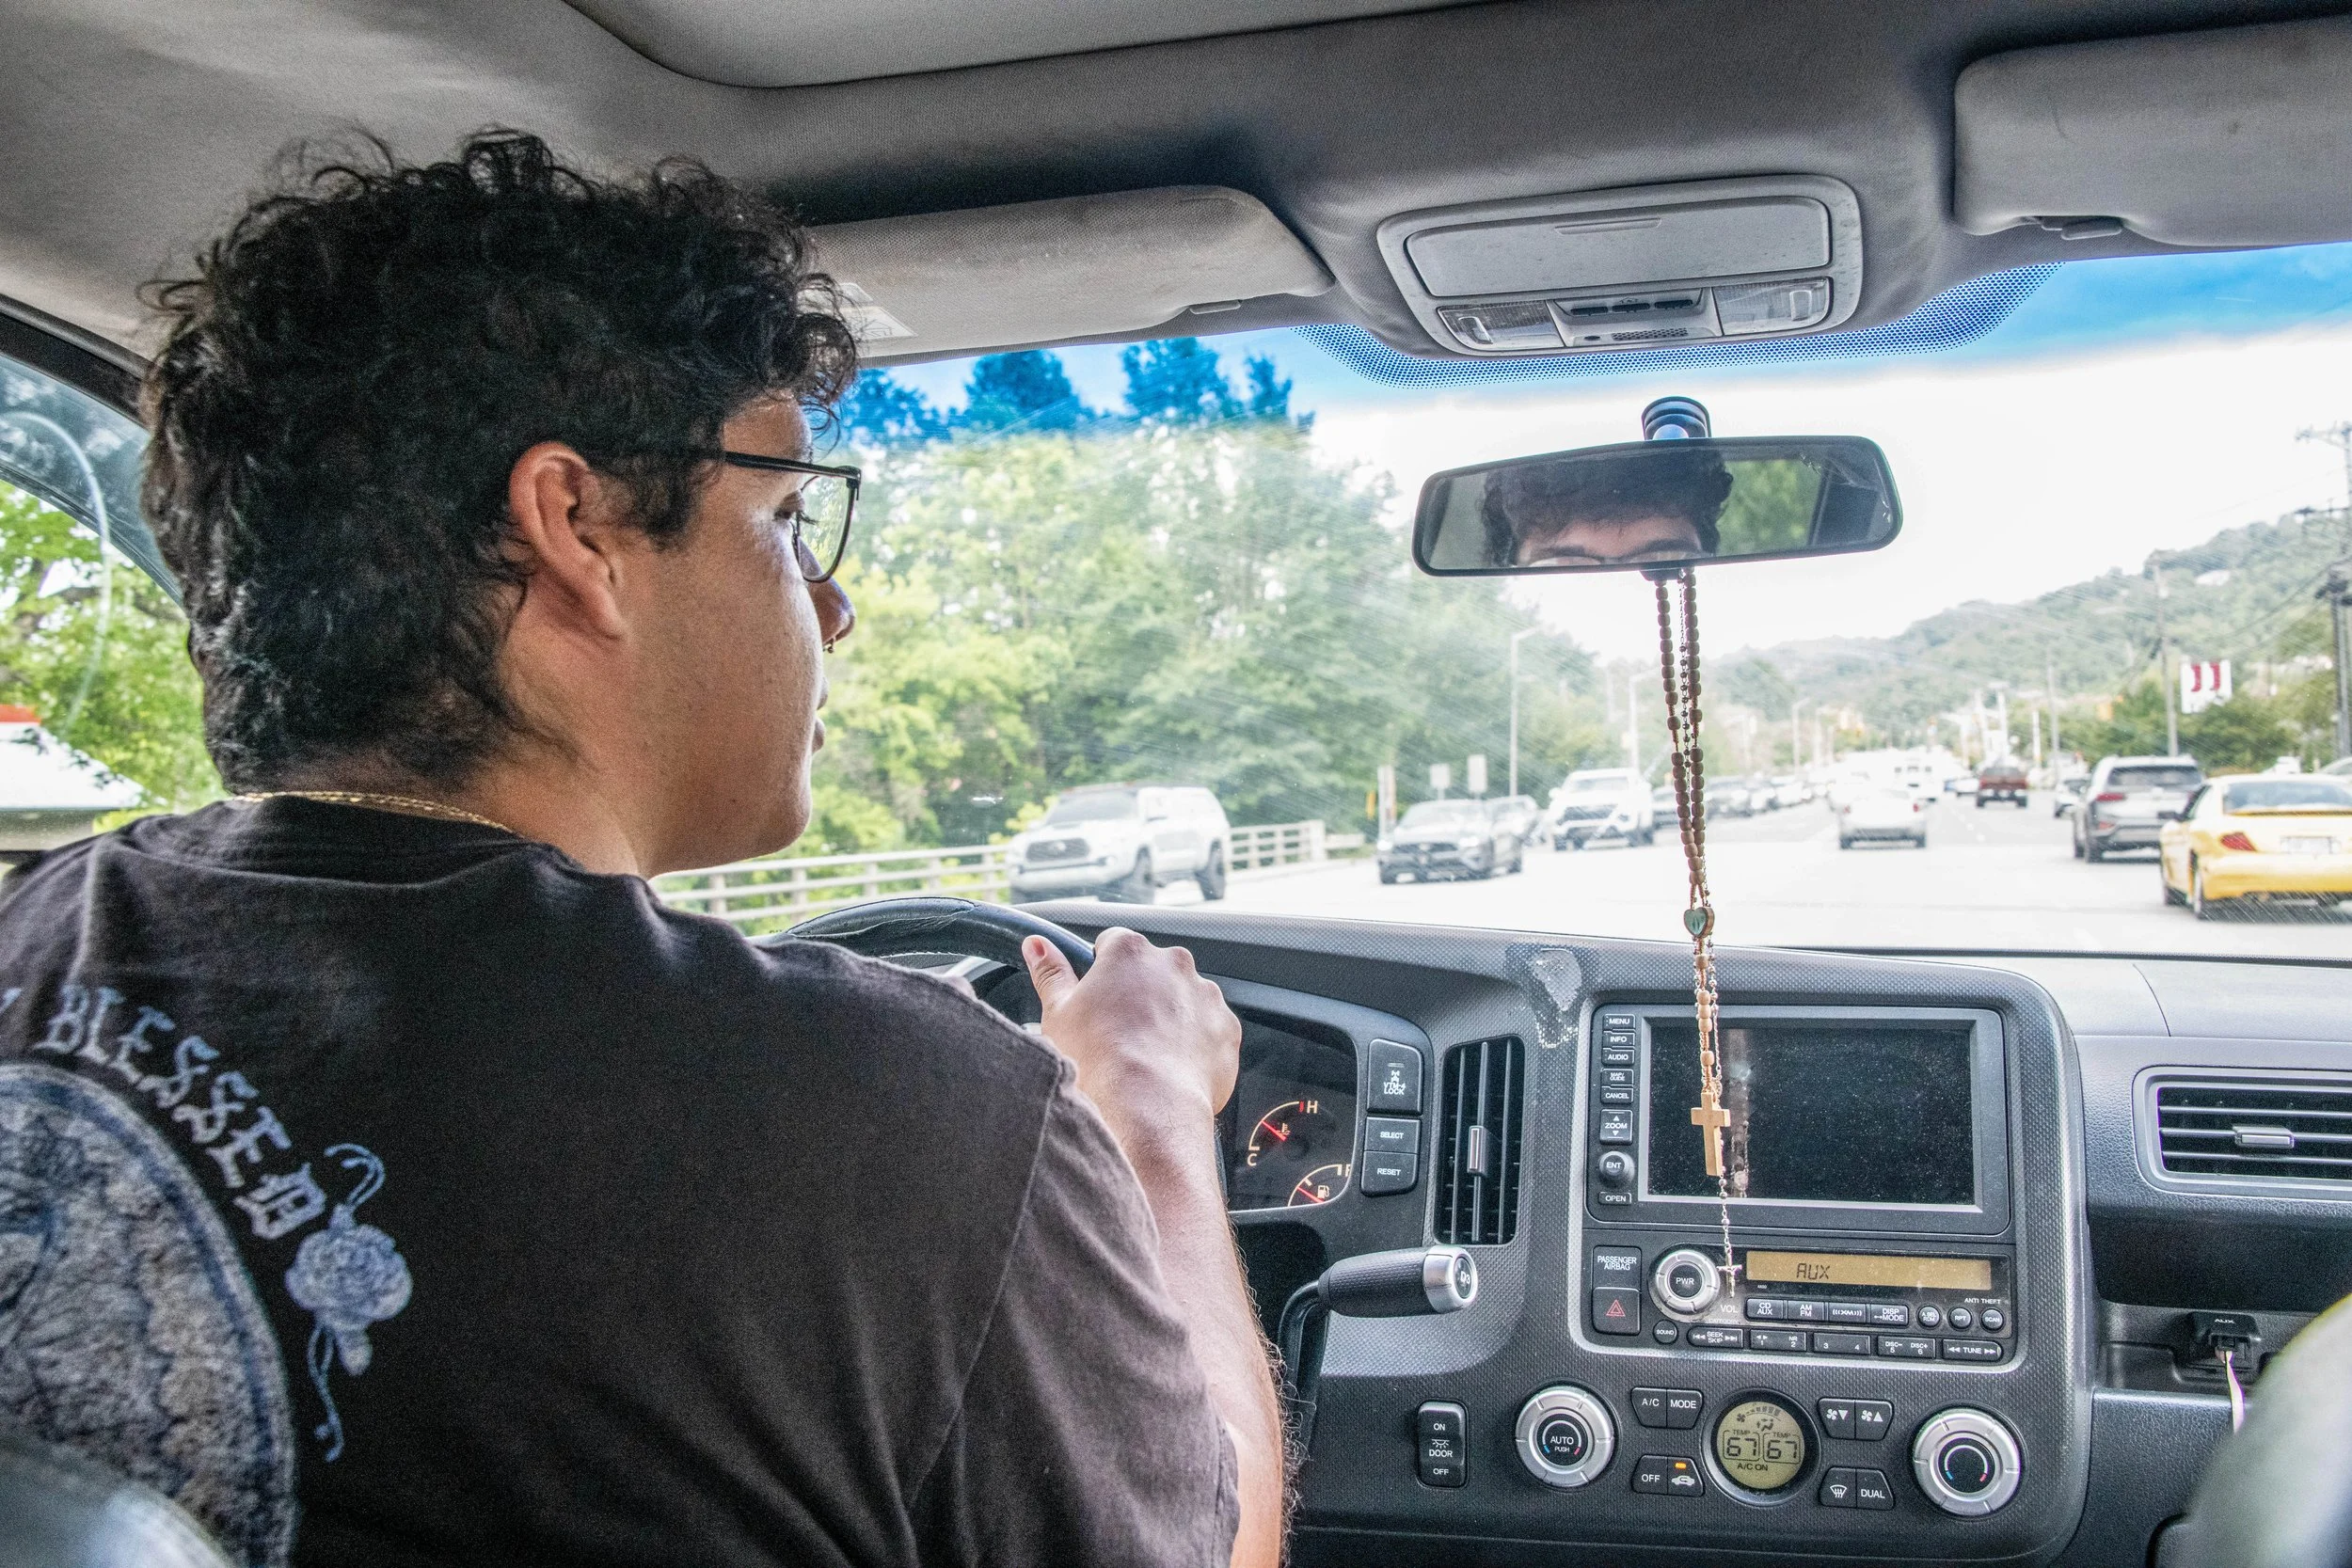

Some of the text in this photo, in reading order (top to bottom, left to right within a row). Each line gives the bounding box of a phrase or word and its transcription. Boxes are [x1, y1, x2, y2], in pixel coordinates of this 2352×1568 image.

[1307, 1101, 1318, 1114] H
[33, 985, 327, 1240] BLESSED
[1379, 1132, 1404, 1140] SELECT
[1247, 1153, 1257, 1166] C
[1377, 1167, 1402, 1176] RESET
[1597, 1255, 1637, 1264] PASSENGER
[1603, 1262, 1631, 1271] AIRBAG
[1796, 1262, 1831, 1280] AUX
[1676, 1277, 1694, 1286] PWR
[1721, 1305, 1739, 1313] VOL
[1757, 1307, 1773, 1316] AUX
[1963, 1346, 1982, 1354] TUNE
[1641, 1398, 1660, 1407] A/C
[1670, 1400, 1697, 1409] MODE
[1433, 1422, 1446, 1431] ON
[1549, 1435, 1575, 1446] AUTO
[1726, 1436, 1757, 1457] 67
[1766, 1439, 1798, 1459] 67
[1428, 1449, 1454, 1458] DOOR
[1737, 1462, 1769, 1471] A/C ON
[1433, 1467, 1450, 1476] OFF
[1641, 1473, 1661, 1483] OFF
[1860, 1489, 1886, 1499] DUAL
